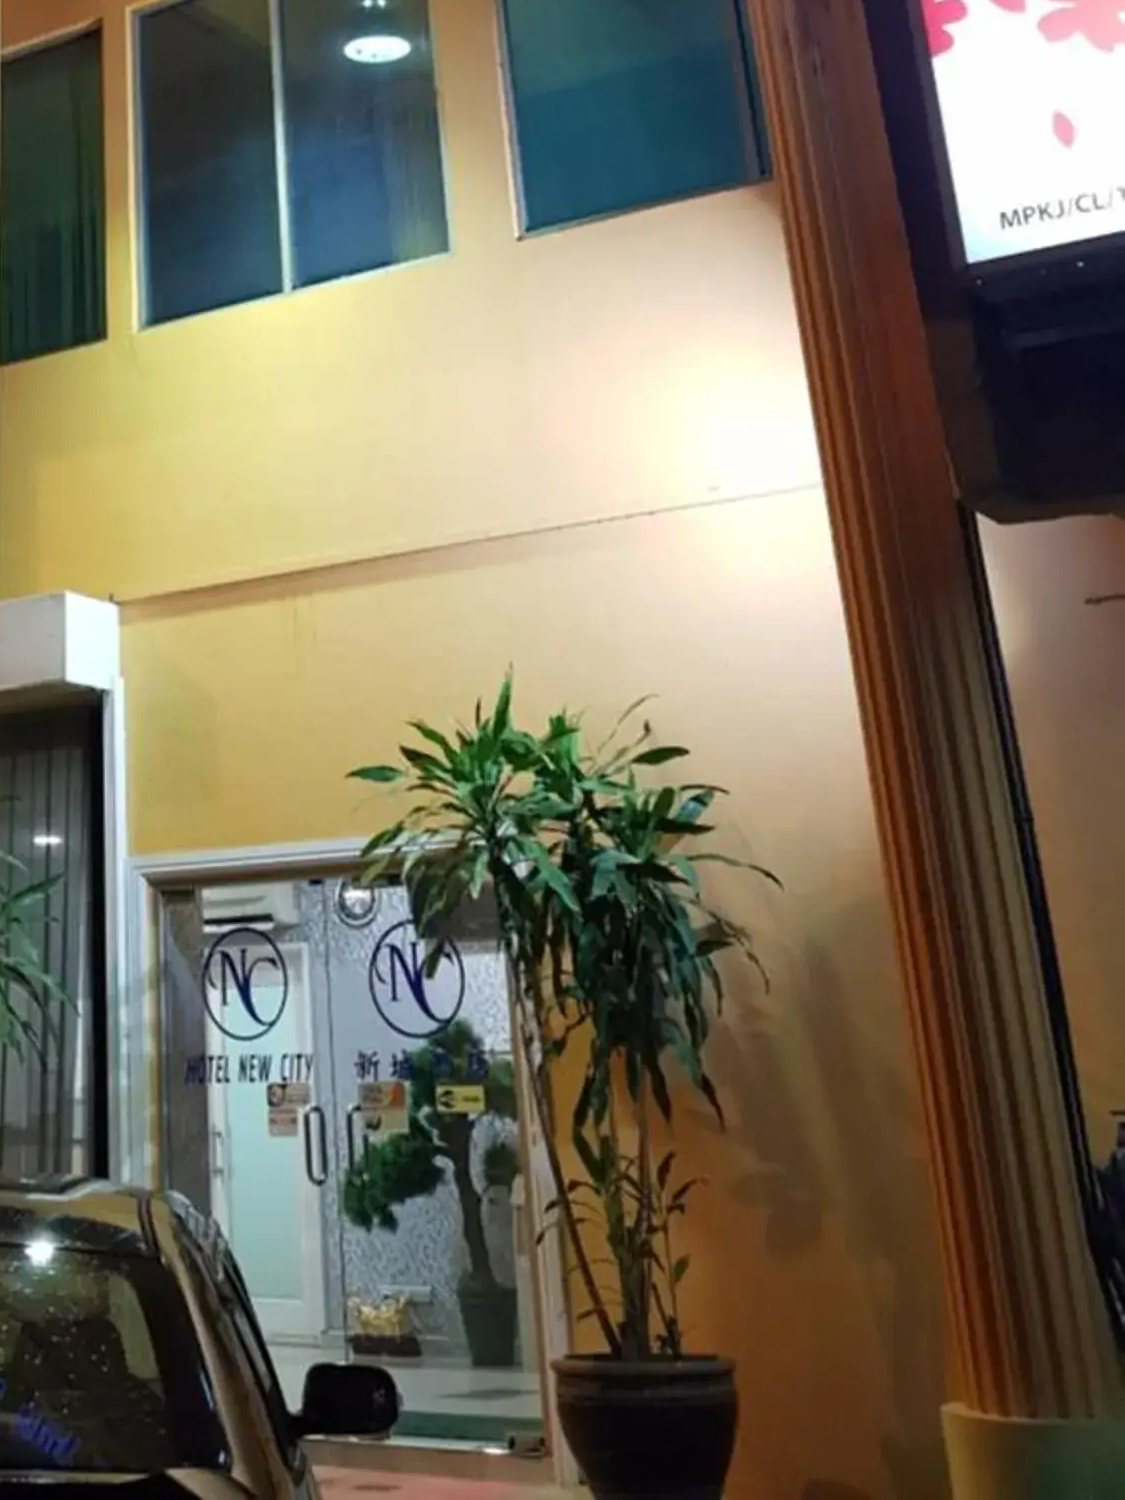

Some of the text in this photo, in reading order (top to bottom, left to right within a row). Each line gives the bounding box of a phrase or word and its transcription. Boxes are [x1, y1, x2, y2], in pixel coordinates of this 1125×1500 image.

[184, 1052, 313, 1086] HOTEL NEW CITY
